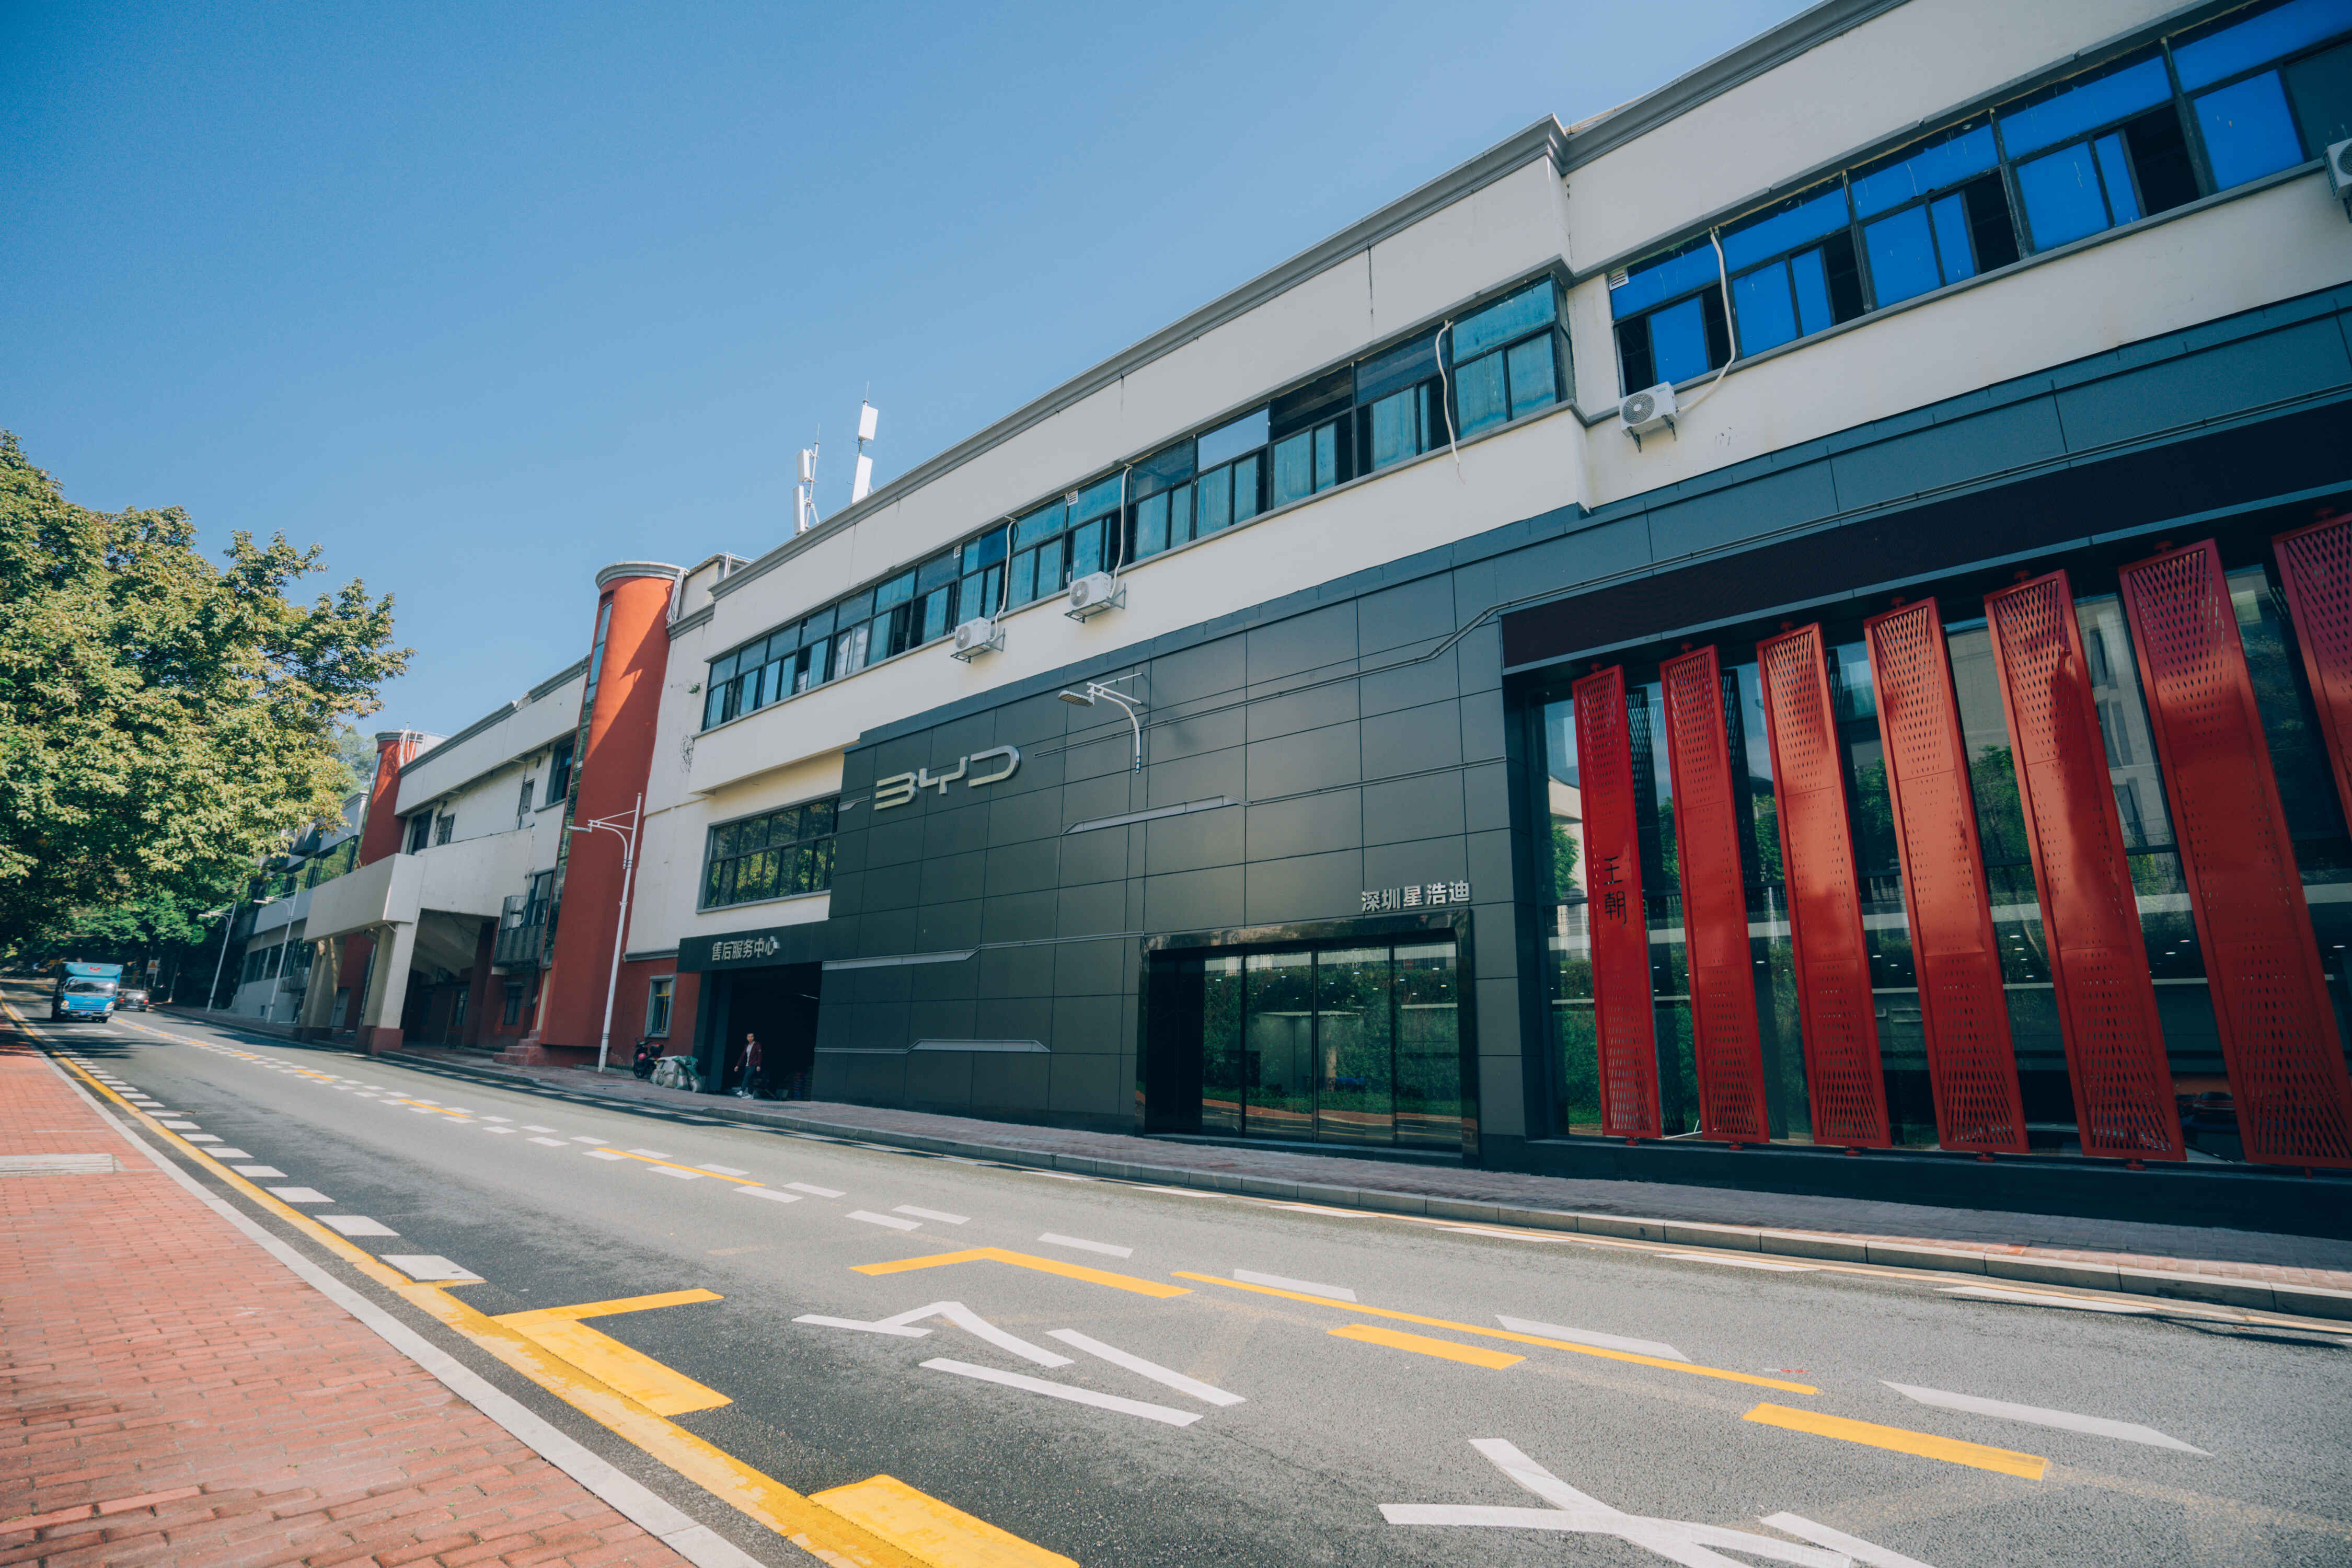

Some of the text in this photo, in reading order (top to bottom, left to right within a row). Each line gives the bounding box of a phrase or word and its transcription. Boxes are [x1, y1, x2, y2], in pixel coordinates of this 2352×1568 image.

[874, 744, 1019, 810] BYD
[1361, 880, 1470, 912] 深圳星浩迪
[1603, 856, 1627, 929] 王朝
[711, 938, 777, 962] 售后服务中心
